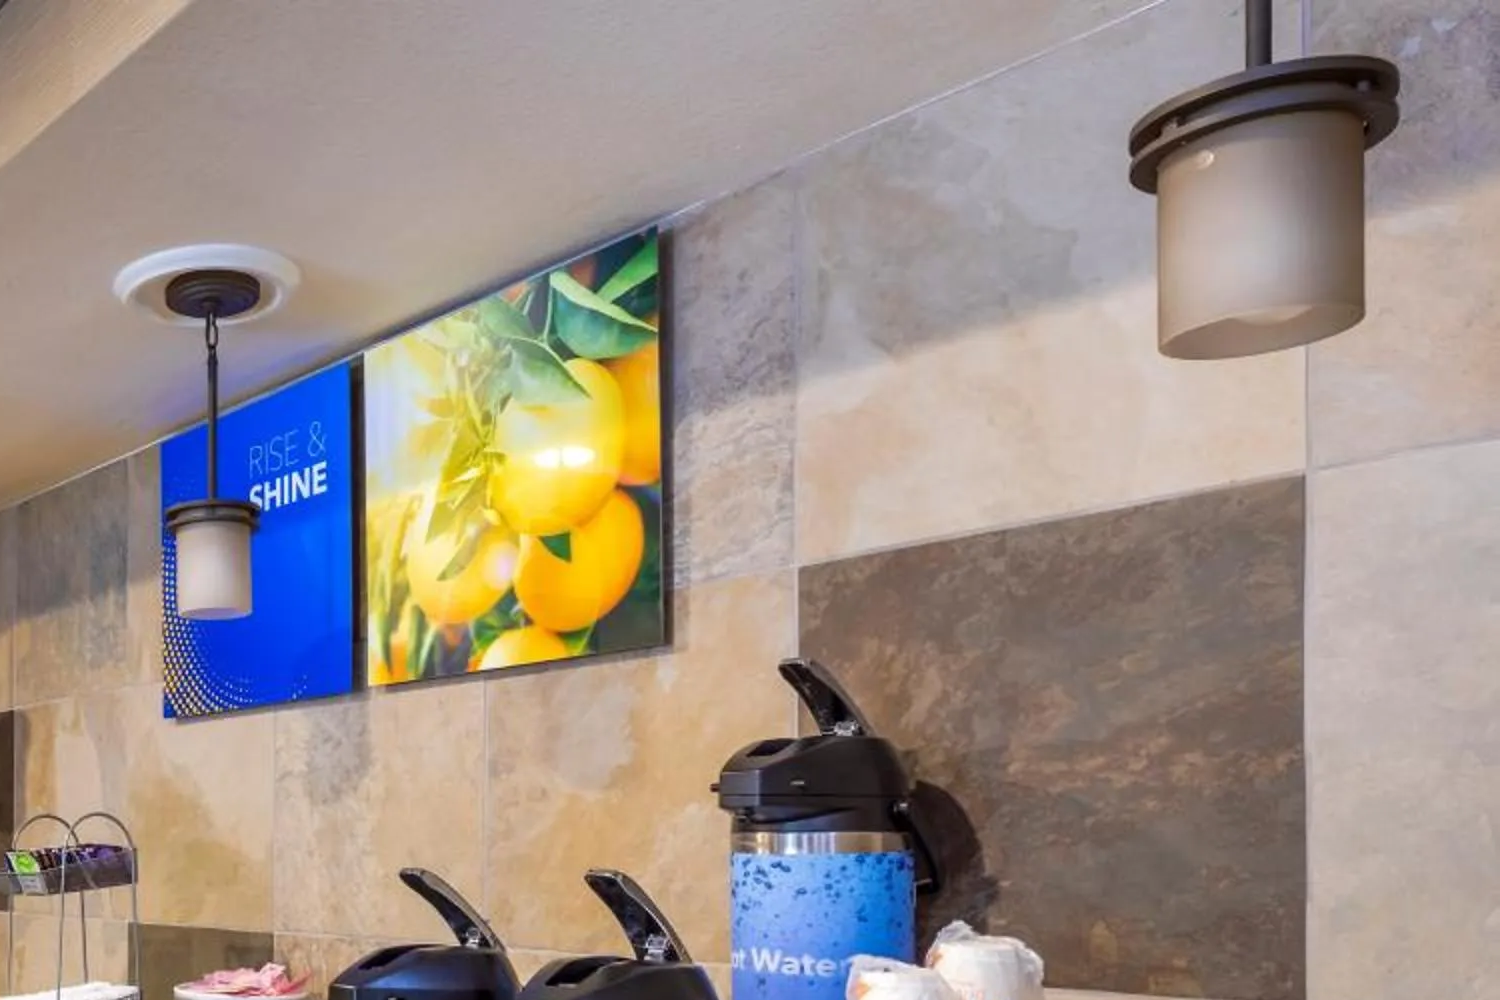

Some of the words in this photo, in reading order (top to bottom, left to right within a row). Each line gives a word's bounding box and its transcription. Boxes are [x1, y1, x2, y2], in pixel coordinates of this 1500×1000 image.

[248, 429, 300, 480] RISE
[307, 420, 328, 458] &
[248, 460, 329, 513] SHINE
[730, 948, 746, 971] ot
